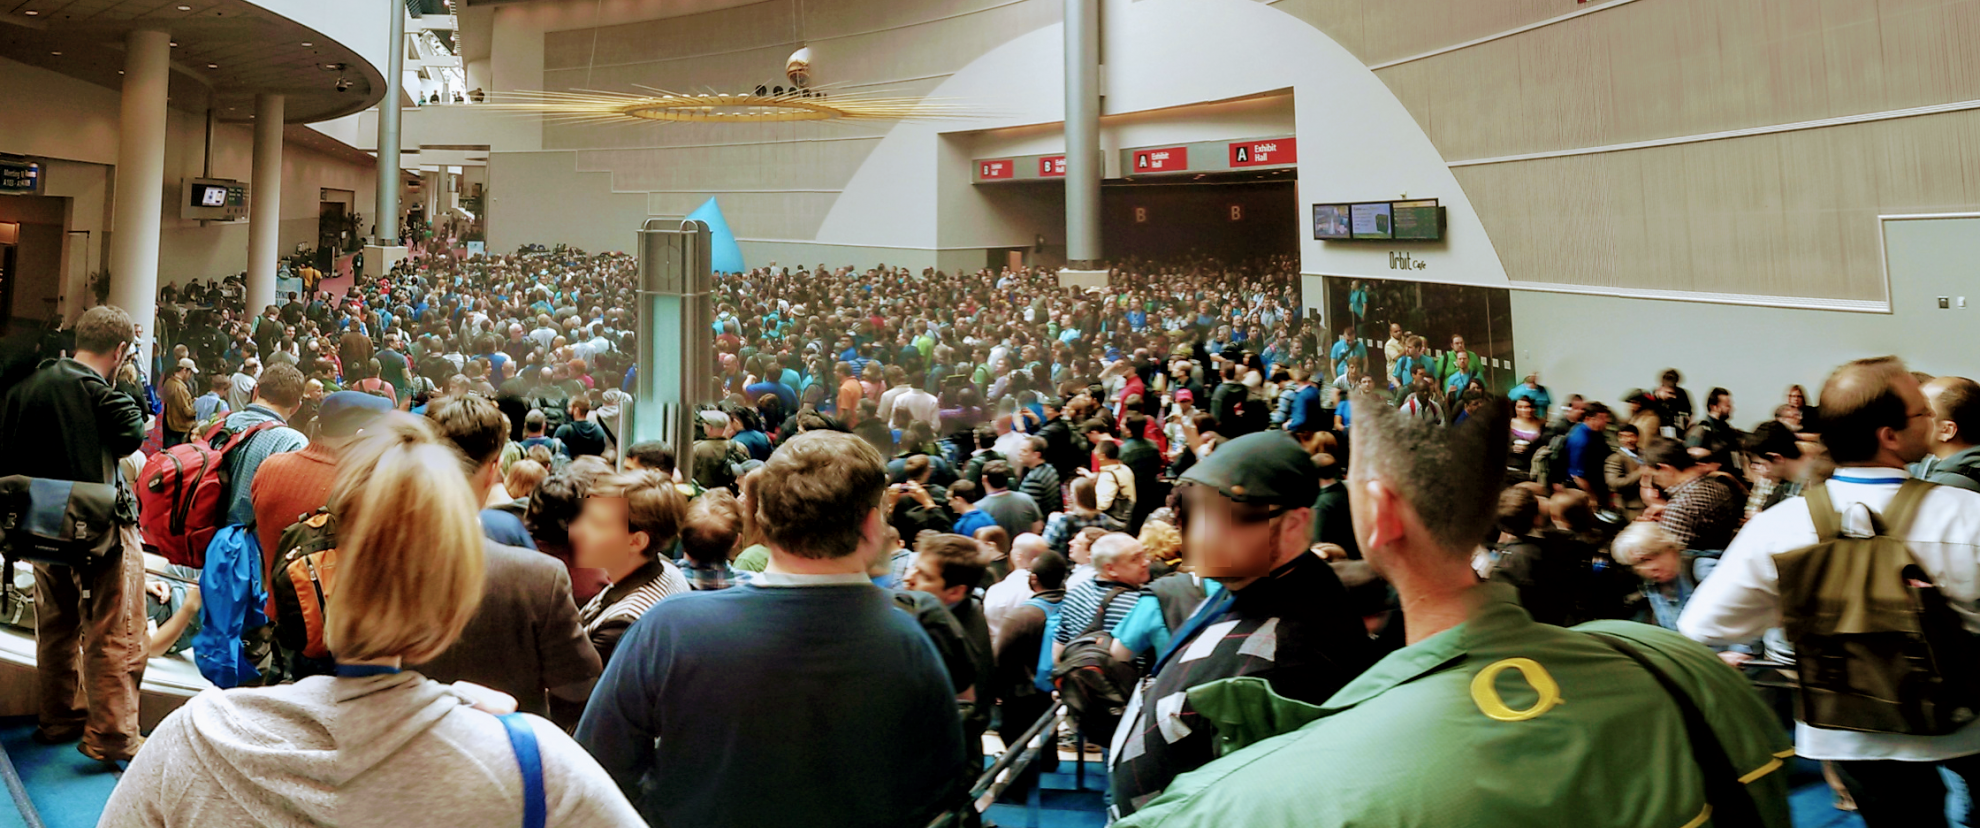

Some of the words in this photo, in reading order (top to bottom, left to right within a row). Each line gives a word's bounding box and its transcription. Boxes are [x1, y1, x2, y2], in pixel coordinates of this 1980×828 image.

[1237, 147, 1247, 161] A
[1254, 143, 1277, 153] Exhibit
[1139, 155, 1147, 168] A
[1254, 152, 1268, 162] Hall
[1044, 161, 1051, 172] B
[1151, 160, 1162, 168] Hall
[1136, 207, 1146, 222] B
[1231, 205, 1241, 220] B
[1389, 251, 1412, 270] Orbit
